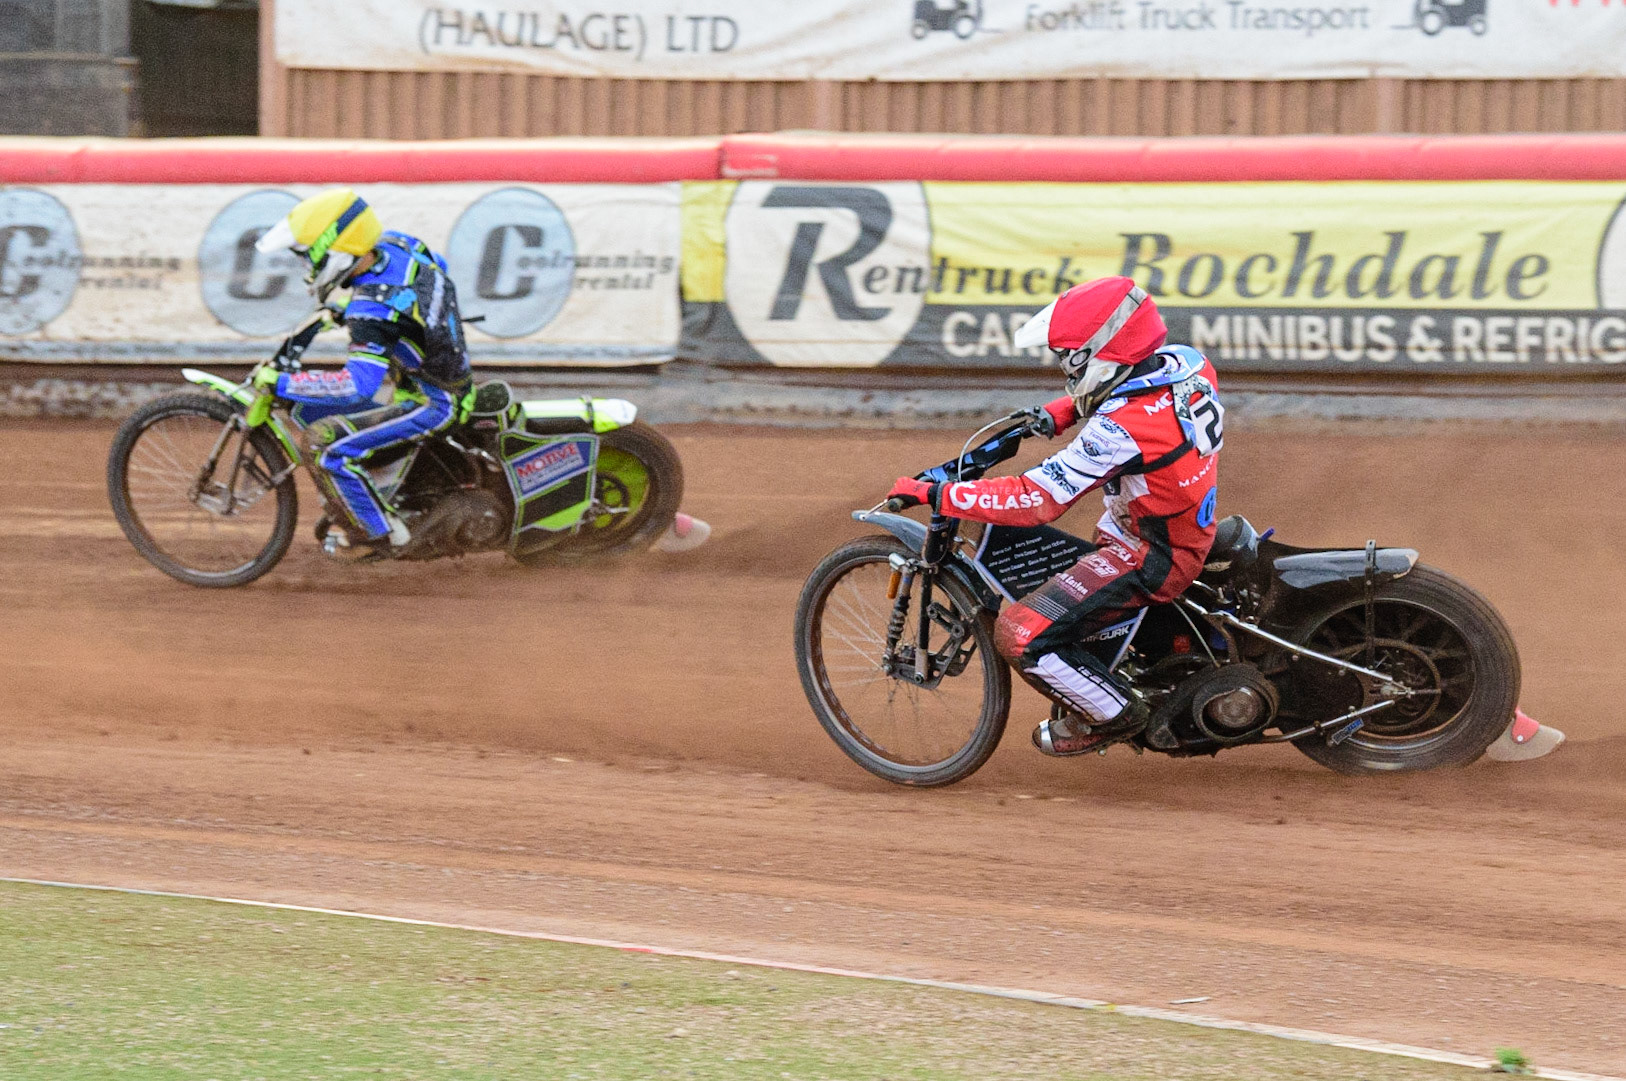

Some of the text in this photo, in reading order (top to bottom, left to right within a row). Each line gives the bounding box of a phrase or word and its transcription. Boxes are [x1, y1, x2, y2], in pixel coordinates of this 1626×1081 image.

[419, 8, 739, 61] (HAULAGE) LTD
[1137, 1, 1214, 31] Truck
[1227, 1, 1369, 36] Transport
[760, 186, 1084, 322] Rentruck
[1118, 231, 1550, 300] Rochdale
[1191, 314, 1397, 363] MINIBUS
[1406, 315, 1443, 363] &
[1453, 316, 1626, 363] REFRIG
[1193, 400, 1223, 450] 2
[978, 490, 1044, 510] GLASS
